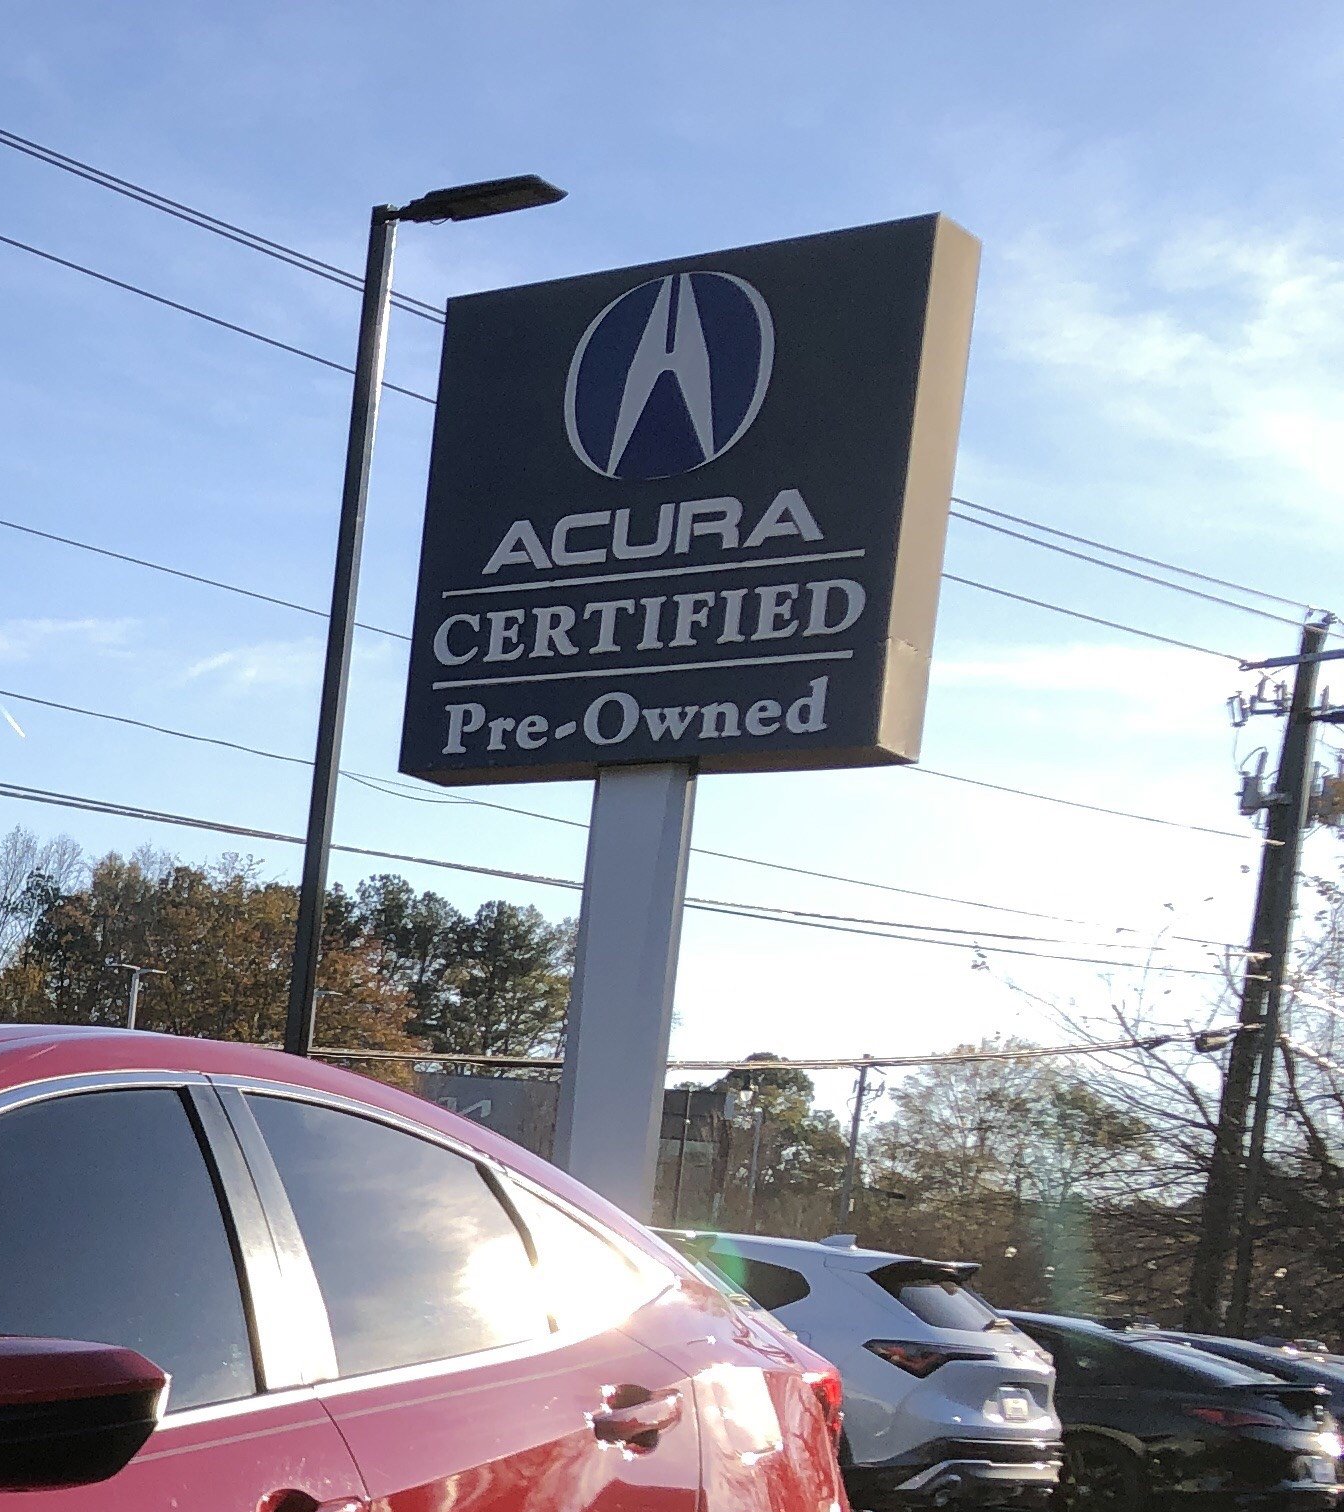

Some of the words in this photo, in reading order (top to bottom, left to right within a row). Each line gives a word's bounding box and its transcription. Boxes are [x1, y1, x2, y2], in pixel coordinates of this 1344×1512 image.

[481, 488, 825, 575] ACURA
[432, 578, 867, 667] CERTIFIED
[441, 675, 829, 755] Pre-Owned
